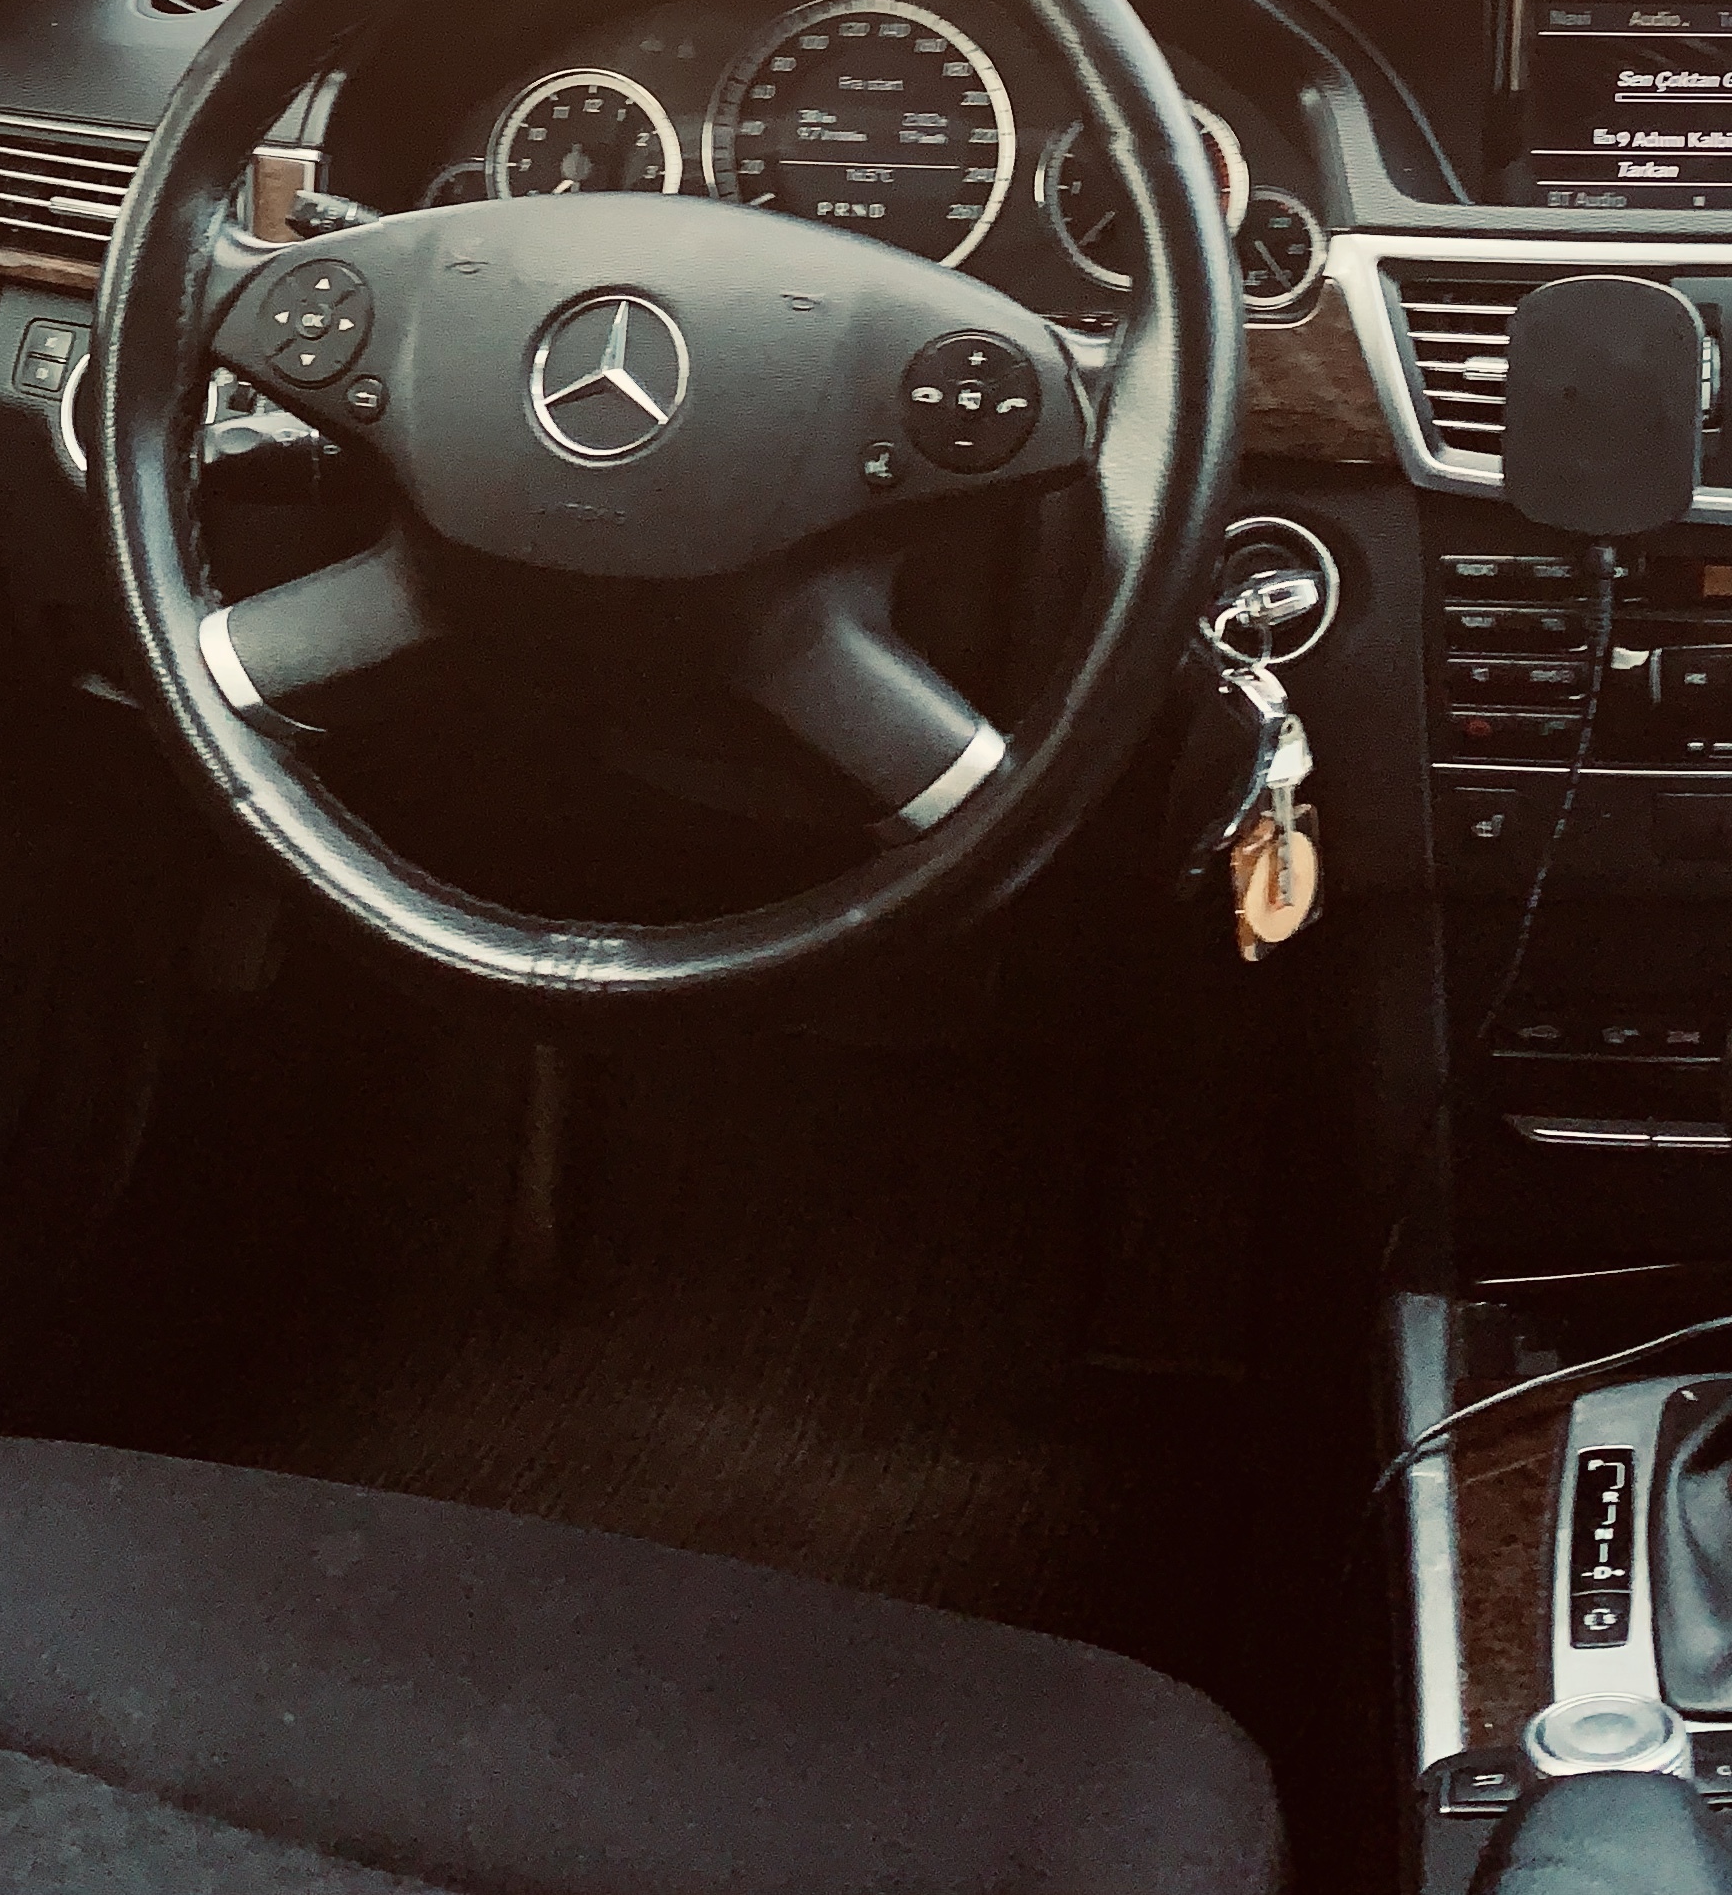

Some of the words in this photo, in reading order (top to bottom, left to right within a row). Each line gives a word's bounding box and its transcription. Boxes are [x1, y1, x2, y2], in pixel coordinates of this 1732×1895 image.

[1628, 11, 1681, 27] Audio
[1617, 71, 1655, 87] Sen
[635, 132, 650, 147] 2
[1618, 161, 1680, 178] Tarkan
[1547, 191, 1574, 207] BT
[1574, 191, 1628, 207] Audio
[301, 313, 325, 328] OK
